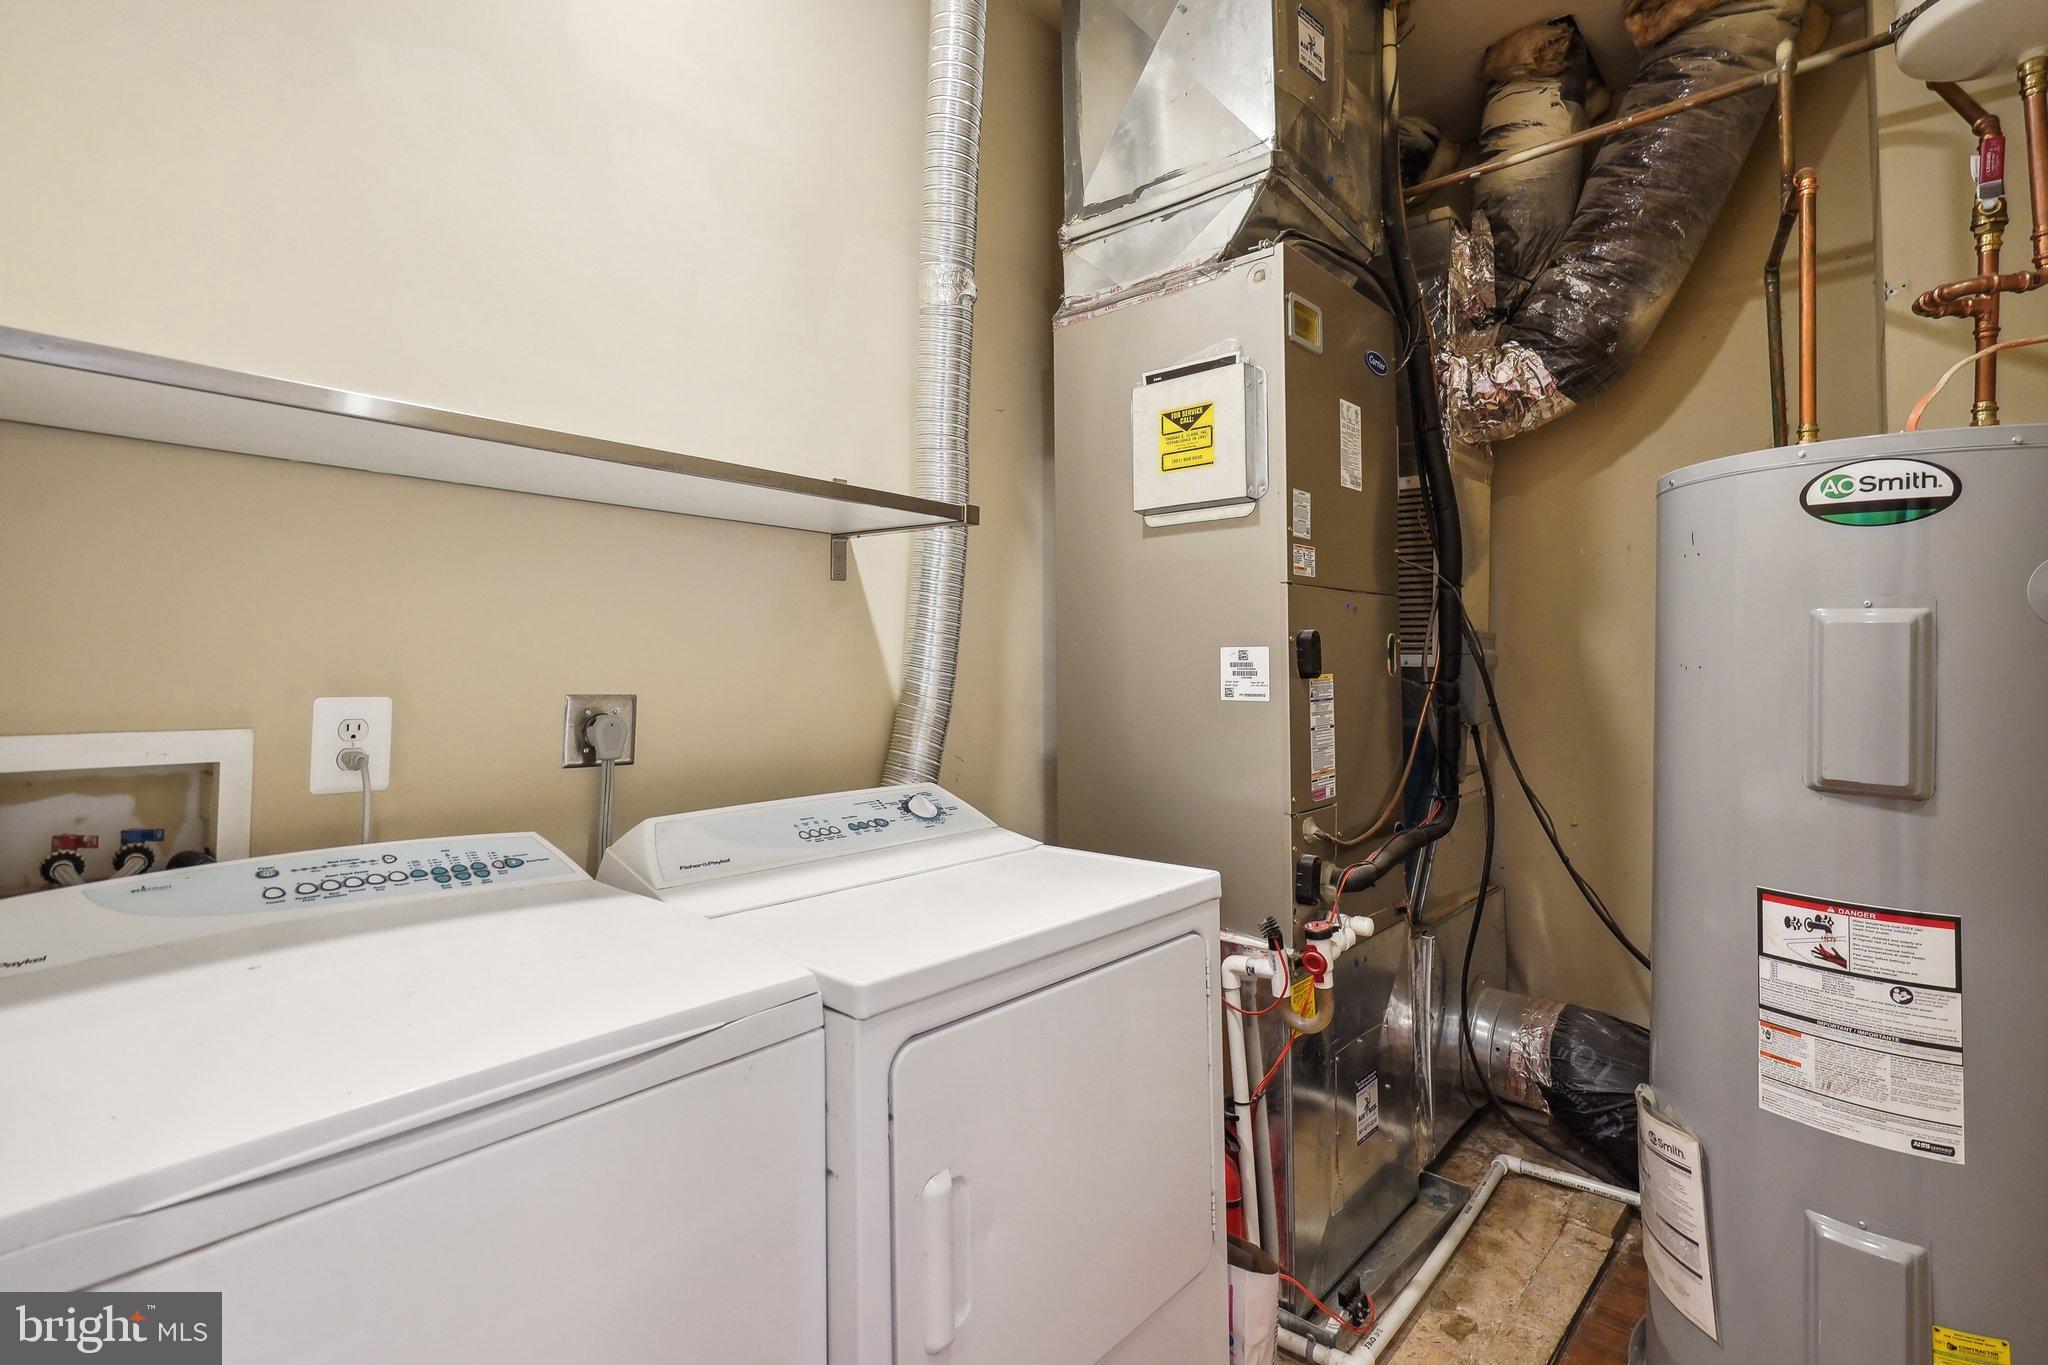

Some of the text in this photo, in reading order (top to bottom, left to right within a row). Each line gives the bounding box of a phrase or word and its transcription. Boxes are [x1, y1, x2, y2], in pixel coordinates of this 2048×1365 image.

[1171, 407, 1204, 420] FOR SERVICE
[1180, 417, 1194, 425] CALL:
[1838, 907, 1877, 920] DANGER
[1816, 1020, 1852, 1033] IMPORTANT
[1857, 1029, 1901, 1043] IMPORTANTE
